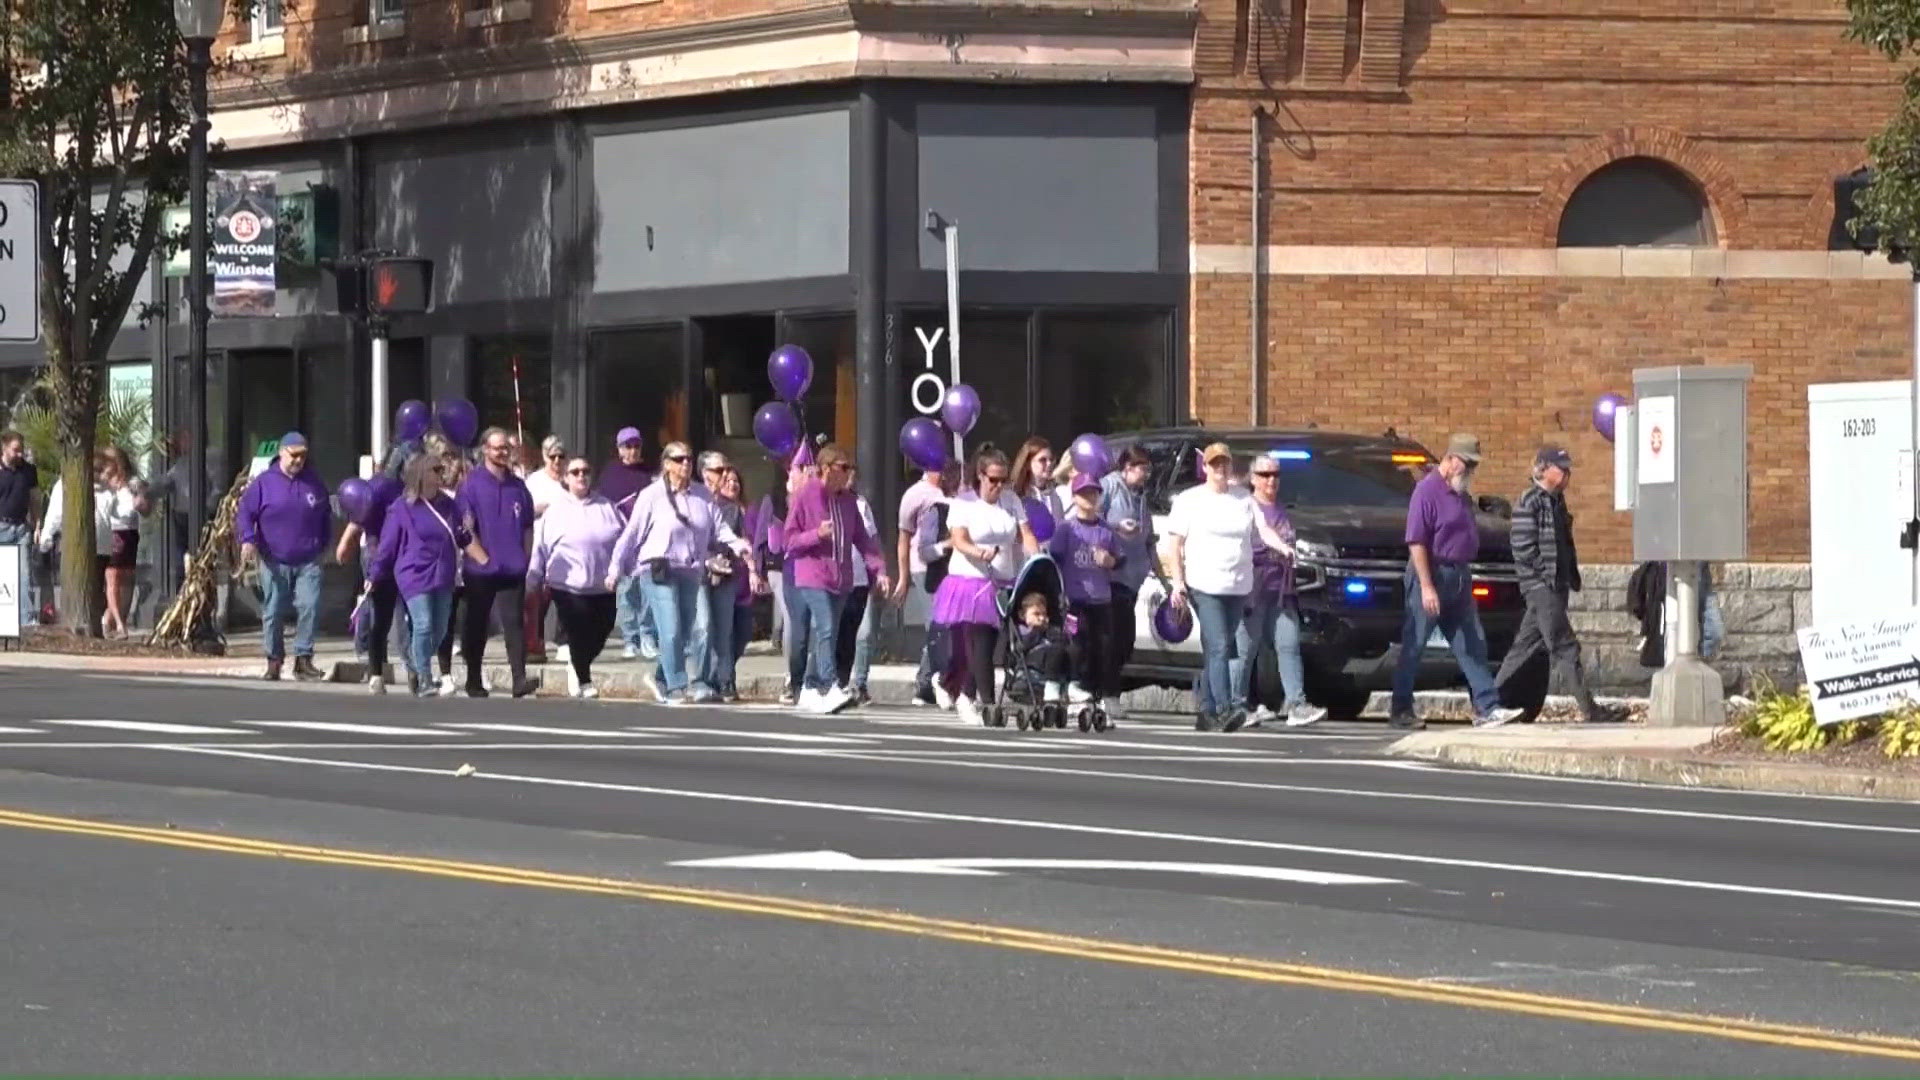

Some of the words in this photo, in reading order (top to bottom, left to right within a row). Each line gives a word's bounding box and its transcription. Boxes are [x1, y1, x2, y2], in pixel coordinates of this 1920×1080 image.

[215, 244, 274, 255] WELCOME
[215, 262, 274, 275] Winsted
[1843, 418, 1876, 437] 162-203
[1805, 632, 1827, 649] The
[1838, 624, 1866, 642] New
[1872, 620, 1918, 637] Image
[1825, 650, 1847, 661] Hair
[1851, 647, 1859, 656] &
[1863, 639, 1902, 653] Tanning
[1852, 654, 1879, 664] Salon
